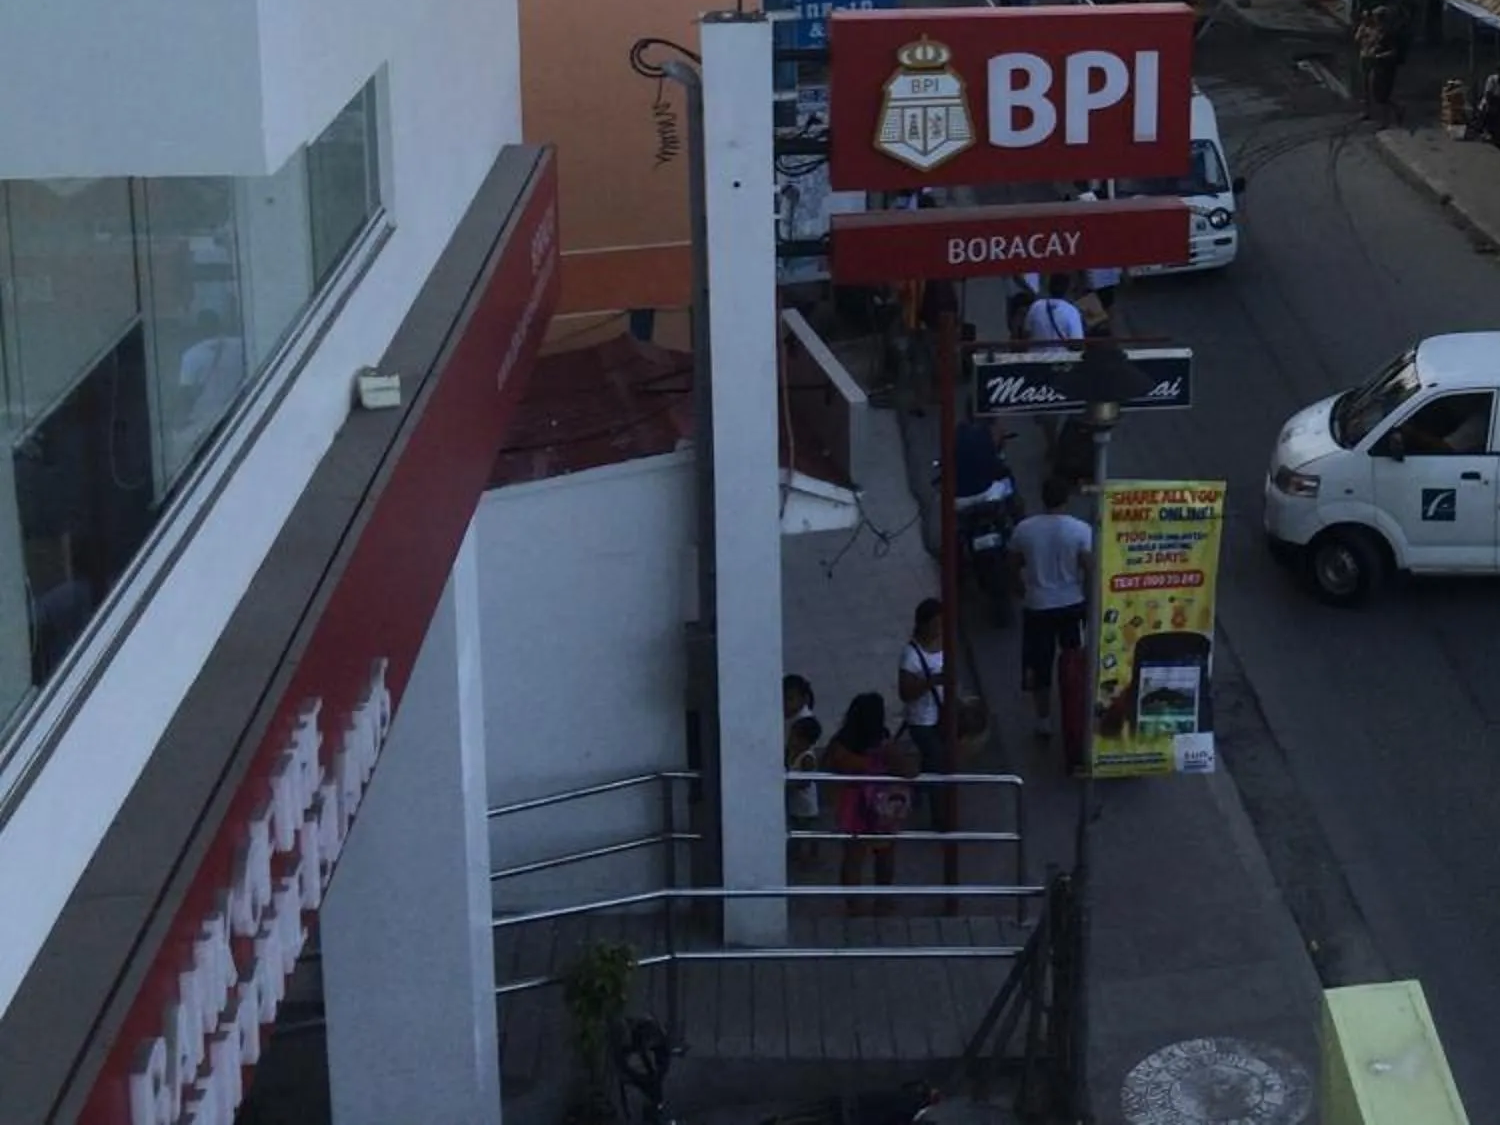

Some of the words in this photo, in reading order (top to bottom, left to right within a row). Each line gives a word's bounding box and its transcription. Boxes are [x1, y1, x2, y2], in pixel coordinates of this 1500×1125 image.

[911, 78, 939, 93] BPI
[987, 50, 1159, 148] BPI
[948, 231, 1080, 264] BORACAY
